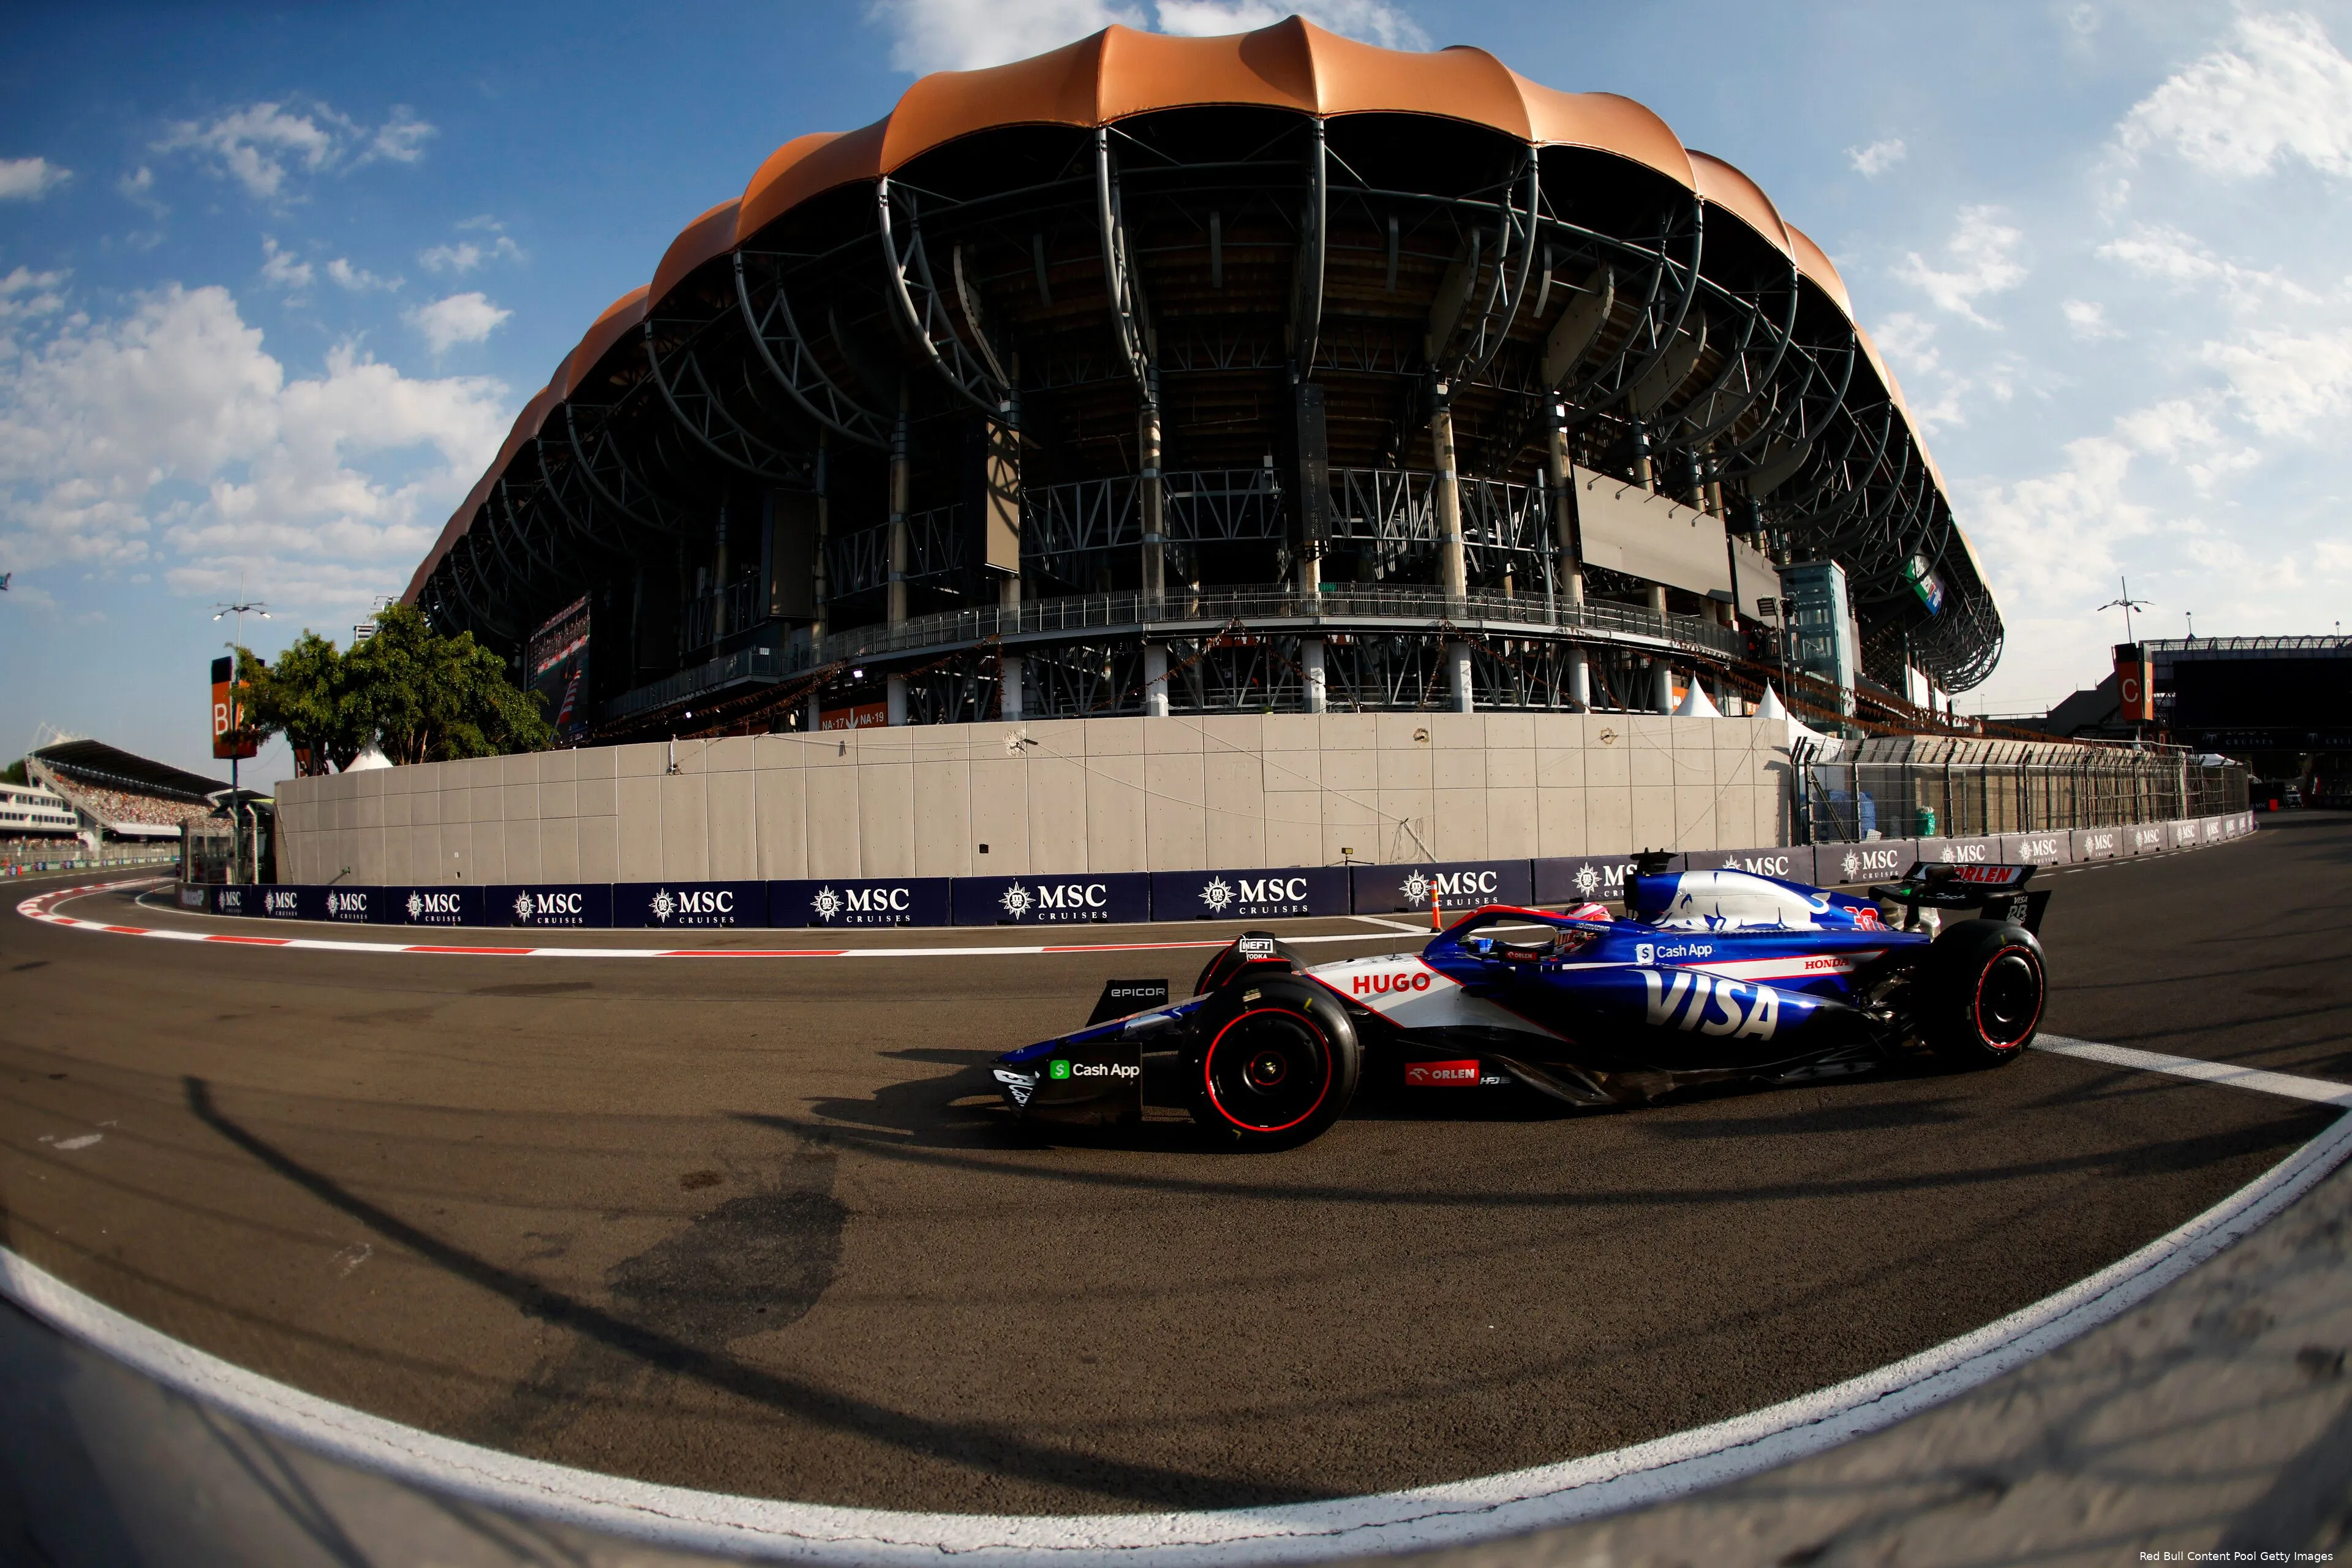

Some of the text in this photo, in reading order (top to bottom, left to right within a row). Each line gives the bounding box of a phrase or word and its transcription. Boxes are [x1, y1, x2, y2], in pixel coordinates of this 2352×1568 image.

[2122, 679, 2138, 703] C
[215, 703, 228, 735] B
[2095, 834, 2113, 850] MSC
[2144, 829, 2160, 843] MSC
[1956, 845, 1985, 863] MSC
[2032, 839, 2057, 856] MSC
[1745, 856, 1789, 876] MSC
[1863, 850, 1898, 870] MSC
[1436, 871, 1498, 895] MSC
[1603, 864, 1638, 886] MS
[1038, 884, 1107, 908] MSC
[1238, 878, 1308, 902] MSC
[276, 892, 297, 908] MSC
[340, 894, 367, 911] MSC
[424, 894, 460, 912] MSC
[537, 893, 582, 913] MSC
[678, 891, 733, 913] MSC
[845, 889, 910, 911] MSC
[1436, 897, 1498, 907] CRUISES
[1038, 911, 1107, 920] CRUISES
[1239, 905, 1308, 914] CRUISES
[1656, 945, 1686, 959] Cash
[1689, 944, 1713, 957] App
[1804, 957, 1850, 969] HONDA
[1354, 973, 1431, 994] HUGO
[1626, 969, 1779, 1041] VISA
[1072, 1064, 1109, 1077] Cash
[1110, 1064, 1140, 1078] App
[1433, 1069, 1475, 1079] ORLEN
